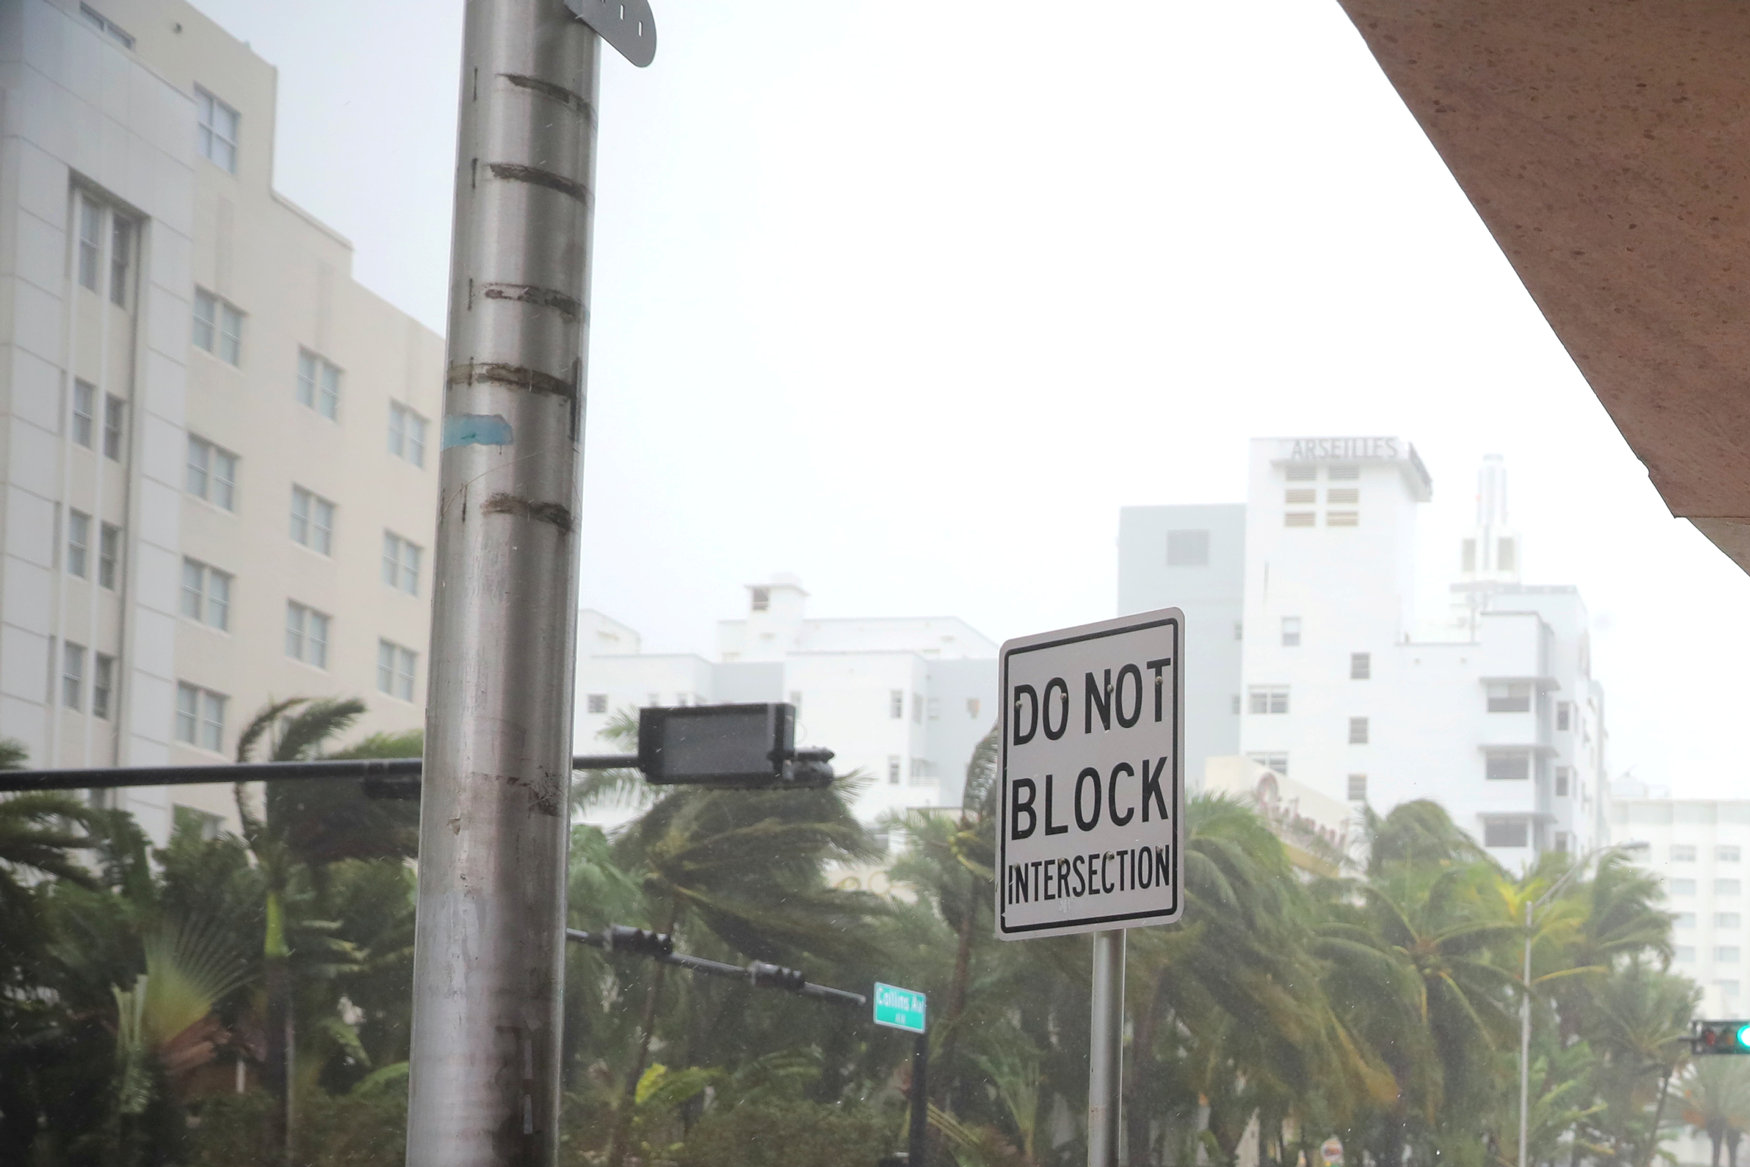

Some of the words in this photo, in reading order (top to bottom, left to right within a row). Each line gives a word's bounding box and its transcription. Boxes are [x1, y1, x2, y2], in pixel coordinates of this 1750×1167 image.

[1292, 438, 1398, 460] ARSEILLES
[1013, 676, 1069, 746] DO
[1085, 657, 1171, 734] NOT
[1011, 756, 1168, 841] BLOCK
[1008, 845, 1170, 905] INTERSECTION
